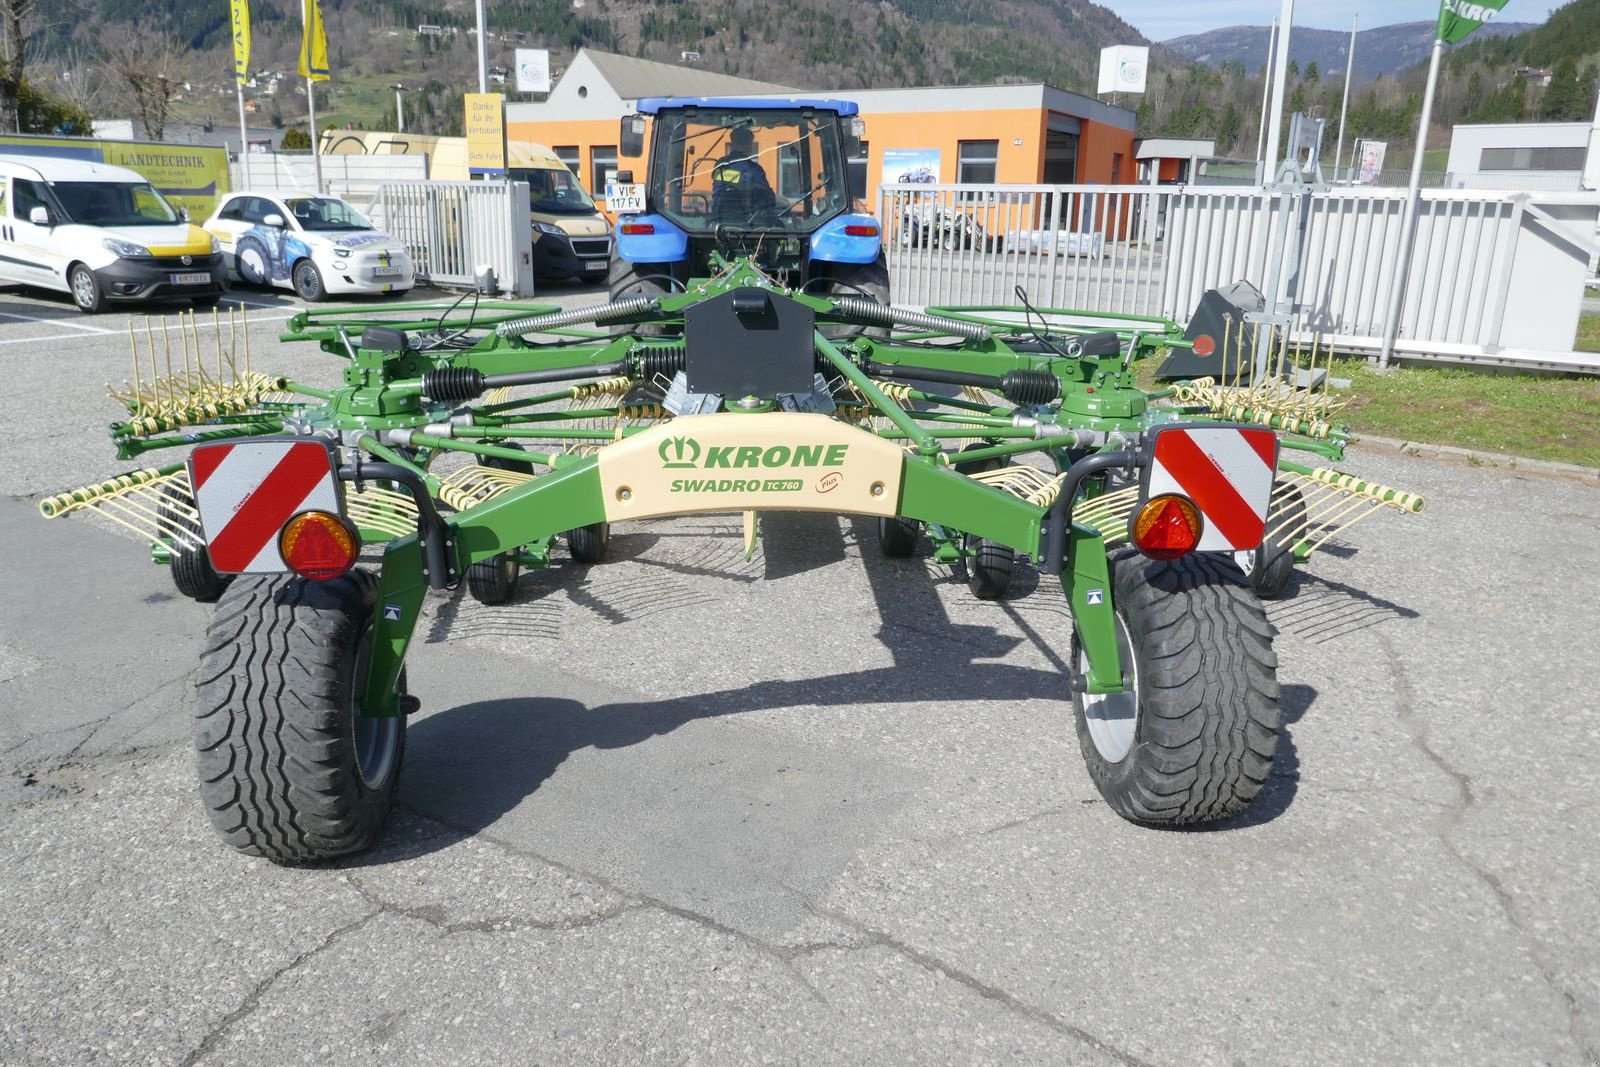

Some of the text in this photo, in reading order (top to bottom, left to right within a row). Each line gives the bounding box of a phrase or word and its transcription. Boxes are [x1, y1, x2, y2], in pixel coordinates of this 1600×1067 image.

[472, 102, 494, 111] Danke
[473, 113, 483, 123] für
[468, 126, 501, 135] Vertrauen
[120, 153, 205, 168] LANDTECHNIK
[469, 152, 484, 161] Gute
[611, 197, 641, 208] 117 FV
[704, 444, 849, 468] KRONE
[670, 476, 838, 492] SWADRO TC 760 Plus
